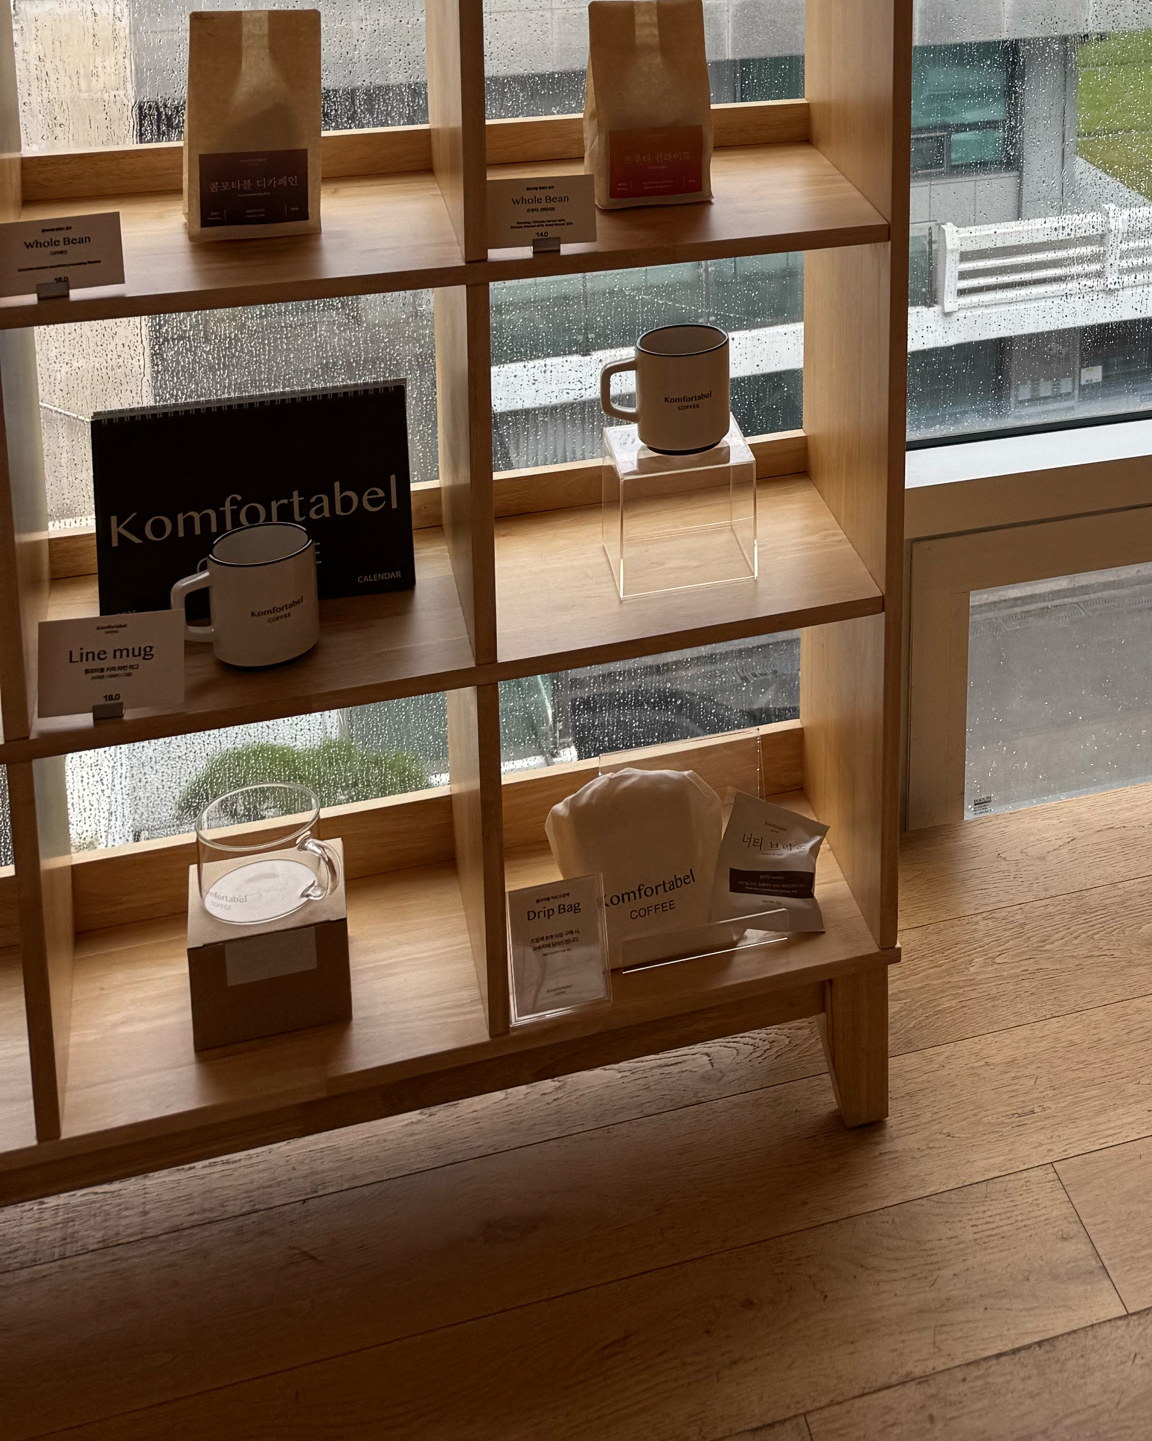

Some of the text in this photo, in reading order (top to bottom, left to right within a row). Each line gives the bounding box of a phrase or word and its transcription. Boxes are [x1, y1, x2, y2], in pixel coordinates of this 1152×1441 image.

[511, 195, 569, 206] Whole Bean
[23, 236, 91, 249] Whole Bean
[664, 390, 712, 404] Komfortabel
[110, 474, 398, 548] Komfortabel
[357, 570, 402, 584] CALENDAR
[250, 595, 304, 618] Komfortabel
[69, 645, 155, 664] Line mug
[102, 693, 120, 703] 18.0
[742, 832, 763, 851] 너티
[527, 902, 582, 921] Drip Bag
[629, 900, 676, 920] COFFEE
